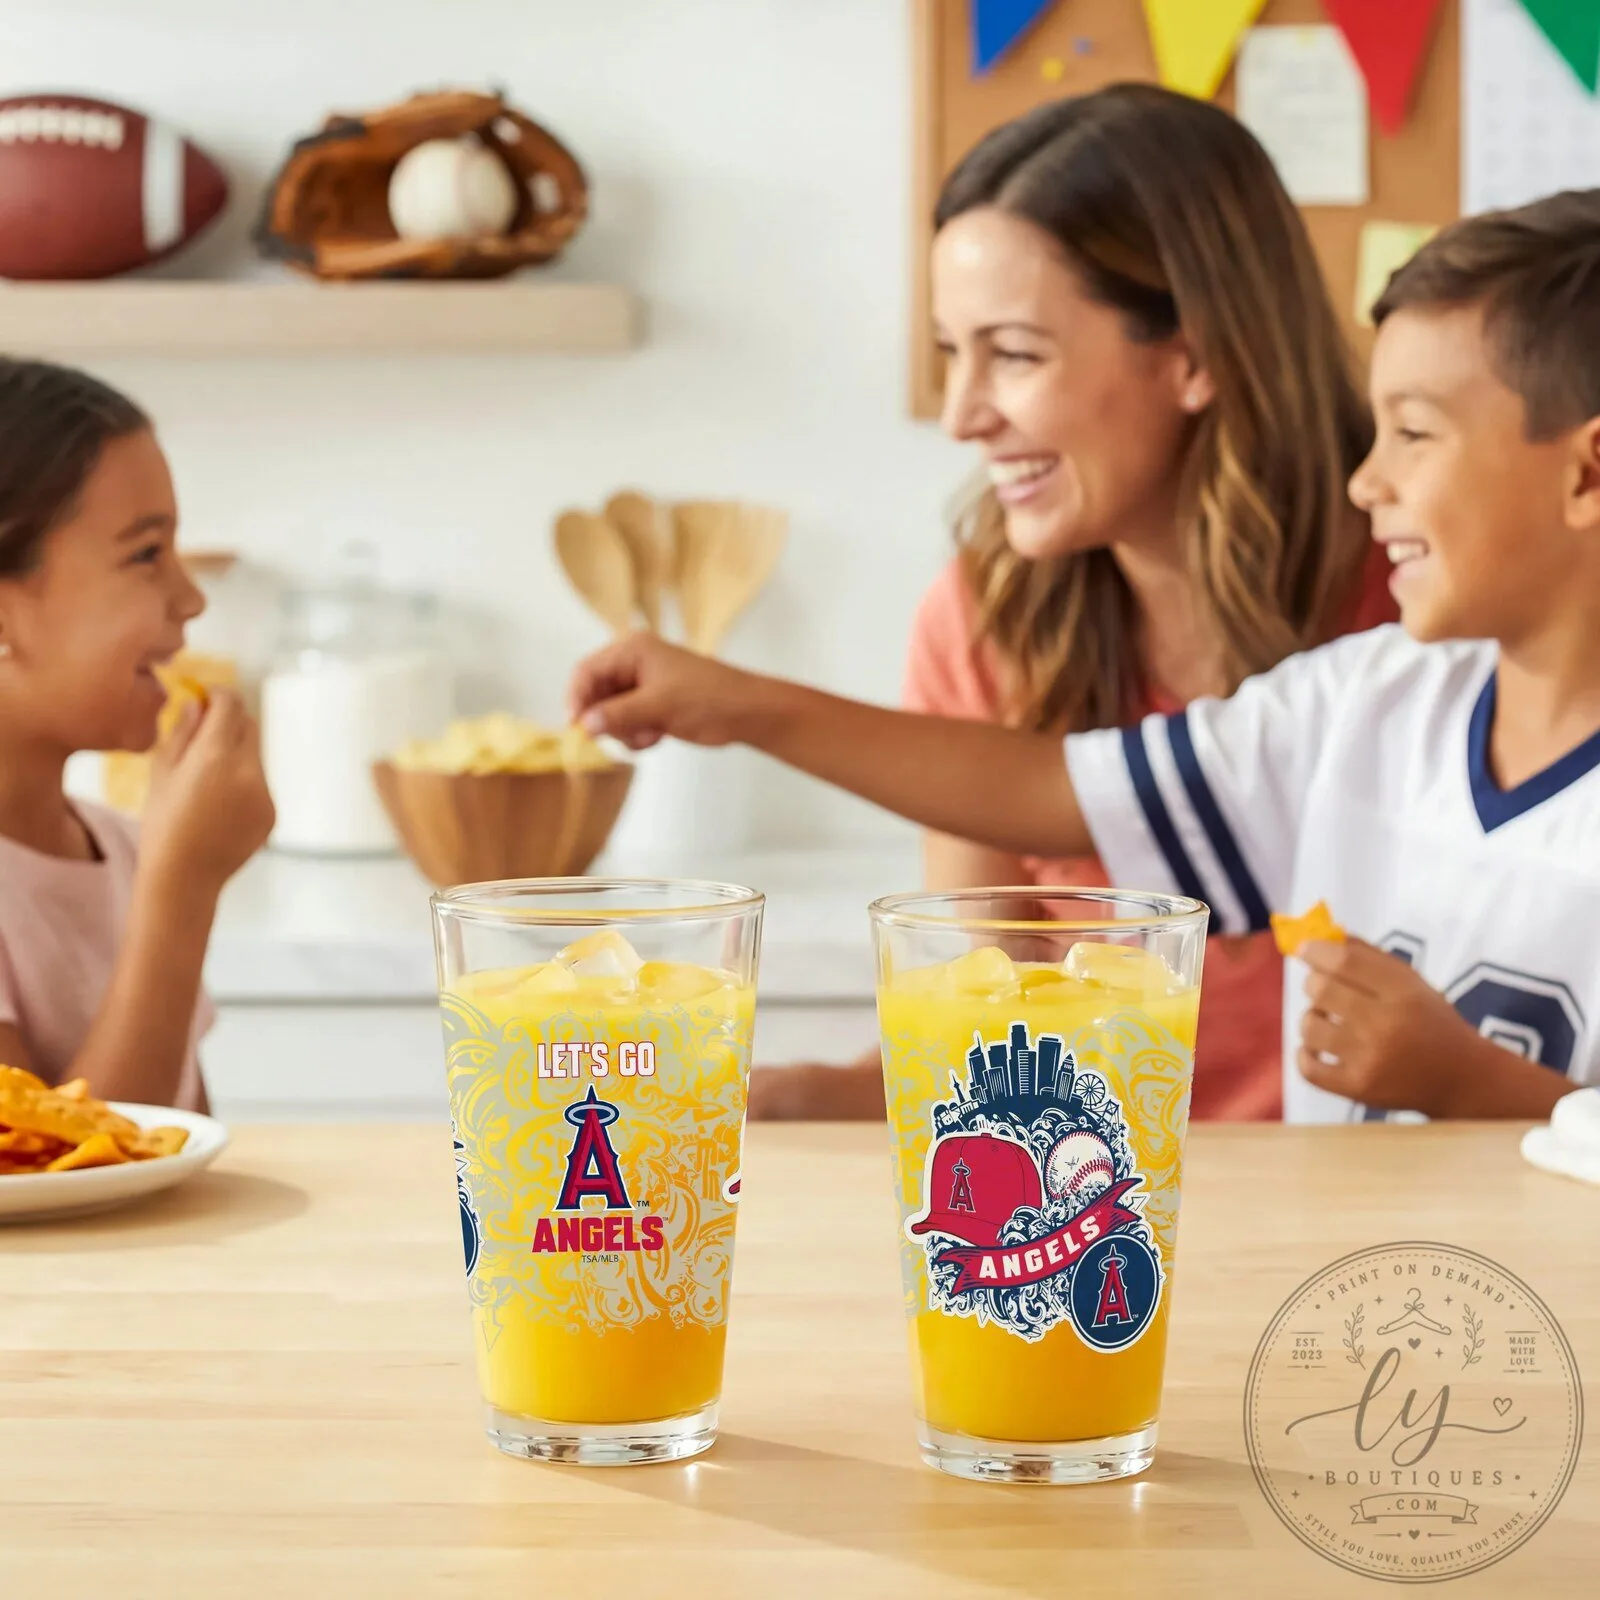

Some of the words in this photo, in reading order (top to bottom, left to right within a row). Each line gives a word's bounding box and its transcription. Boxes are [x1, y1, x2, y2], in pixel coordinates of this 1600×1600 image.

[537, 1042, 609, 1078] LET'S
[618, 1041, 655, 1077] GO
[551, 1083, 637, 1211] A
[948, 1157, 976, 1213] A
[532, 1216, 664, 1253] ANGELS
[582, 1254, 619, 1264] TSA/MLB
[979, 1215, 1101, 1279] ANGELS
[1091, 1244, 1134, 1328] A
